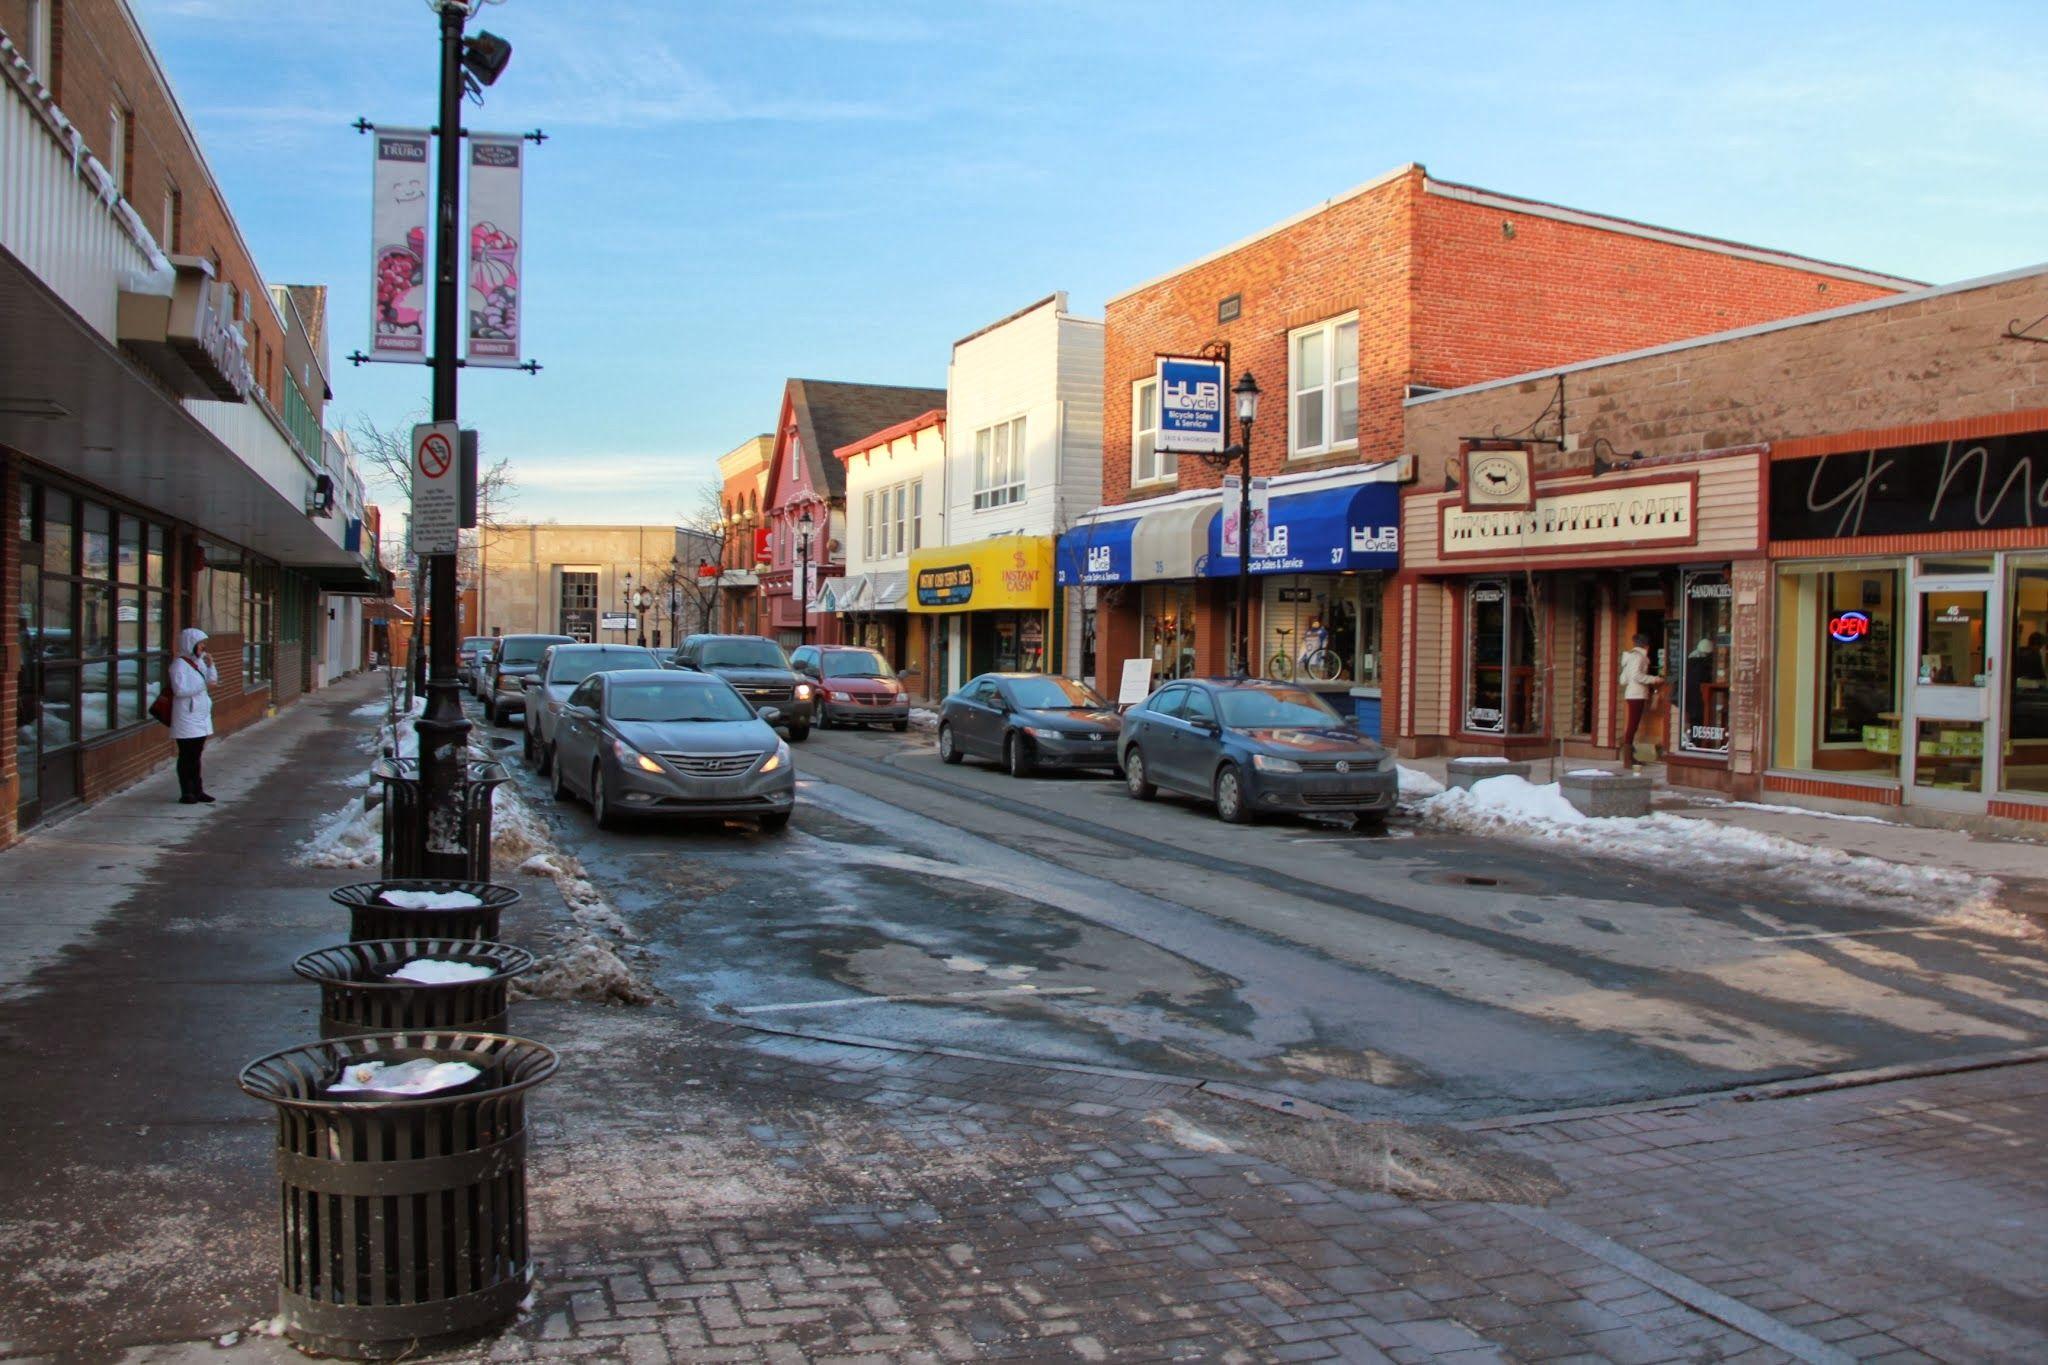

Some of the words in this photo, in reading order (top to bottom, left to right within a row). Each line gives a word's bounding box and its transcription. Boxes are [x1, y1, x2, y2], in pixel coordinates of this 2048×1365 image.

[382, 144, 424, 157] TRURO
[1164, 380, 1218, 396] HUB
[1180, 395, 1216, 409] Cycle
[1168, 411, 1194, 420] Bicycle
[1195, 412, 1214, 421] Sales
[1175, 419, 1181, 427] &
[1182, 420, 1208, 429] Service
[1544, 502, 1623, 532] BAKERY
[1629, 496, 1689, 526] CAFE
[1351, 526, 1398, 541] HUB
[1365, 539, 1396, 552] Cycle
[1331, 548, 1343, 564] 37
[1261, 560, 1276, 570] Sales
[1277, 559, 1282, 568] &
[1282, 557, 1304, 568] Service
[1002, 570, 1039, 581] INSTANT
[1006, 580, 1031, 592] CASH
[1947, 605, 1959, 616] 45
[1829, 618, 1868, 636] OPEN
[1692, 725, 1724, 740] DESSERT
